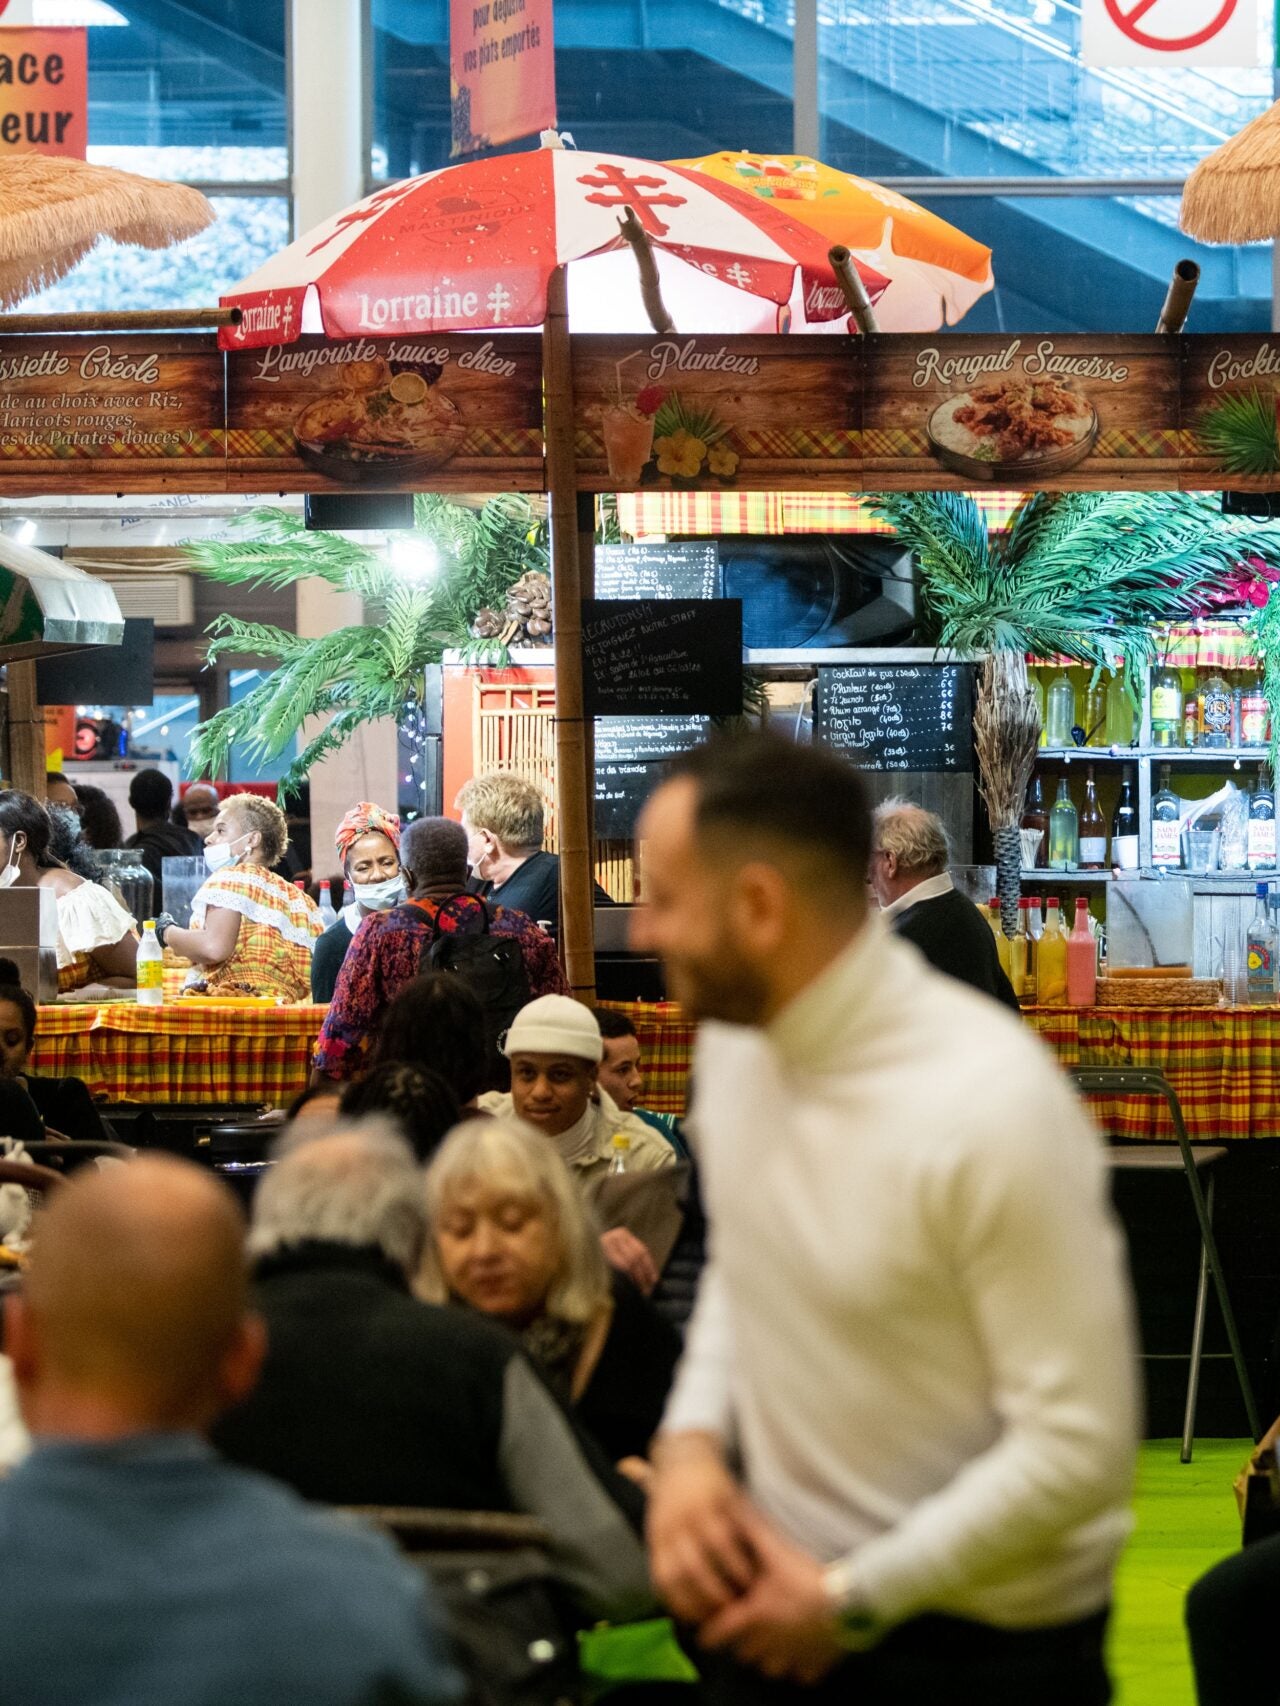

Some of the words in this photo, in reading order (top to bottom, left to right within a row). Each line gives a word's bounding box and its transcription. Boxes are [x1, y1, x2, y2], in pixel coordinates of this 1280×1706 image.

[464, 49, 478, 72] vos
[479, 38, 499, 73] plats
[399, 203, 536, 234] MARTINIQUE
[358, 276, 479, 331] Lorraine
[79, 345, 160, 384] Créole
[252, 338, 377, 383] Langouste
[386, 341, 449, 365] sauce
[457, 341, 517, 377] chien
[647, 338, 760, 380] Planteur
[912, 339, 1021, 388] Rougail
[1022, 340, 1129, 384] Saucisse
[25, 397, 46, 408] au
[52, 393, 99, 408] choix
[104, 395, 143, 408] avec
[149, 391, 183, 409] Riz,
[24, 430, 44, 446] de
[50, 430, 116, 445] Patates
[121, 429, 180, 445] douces
[76, 413, 137, 430] rouges,
